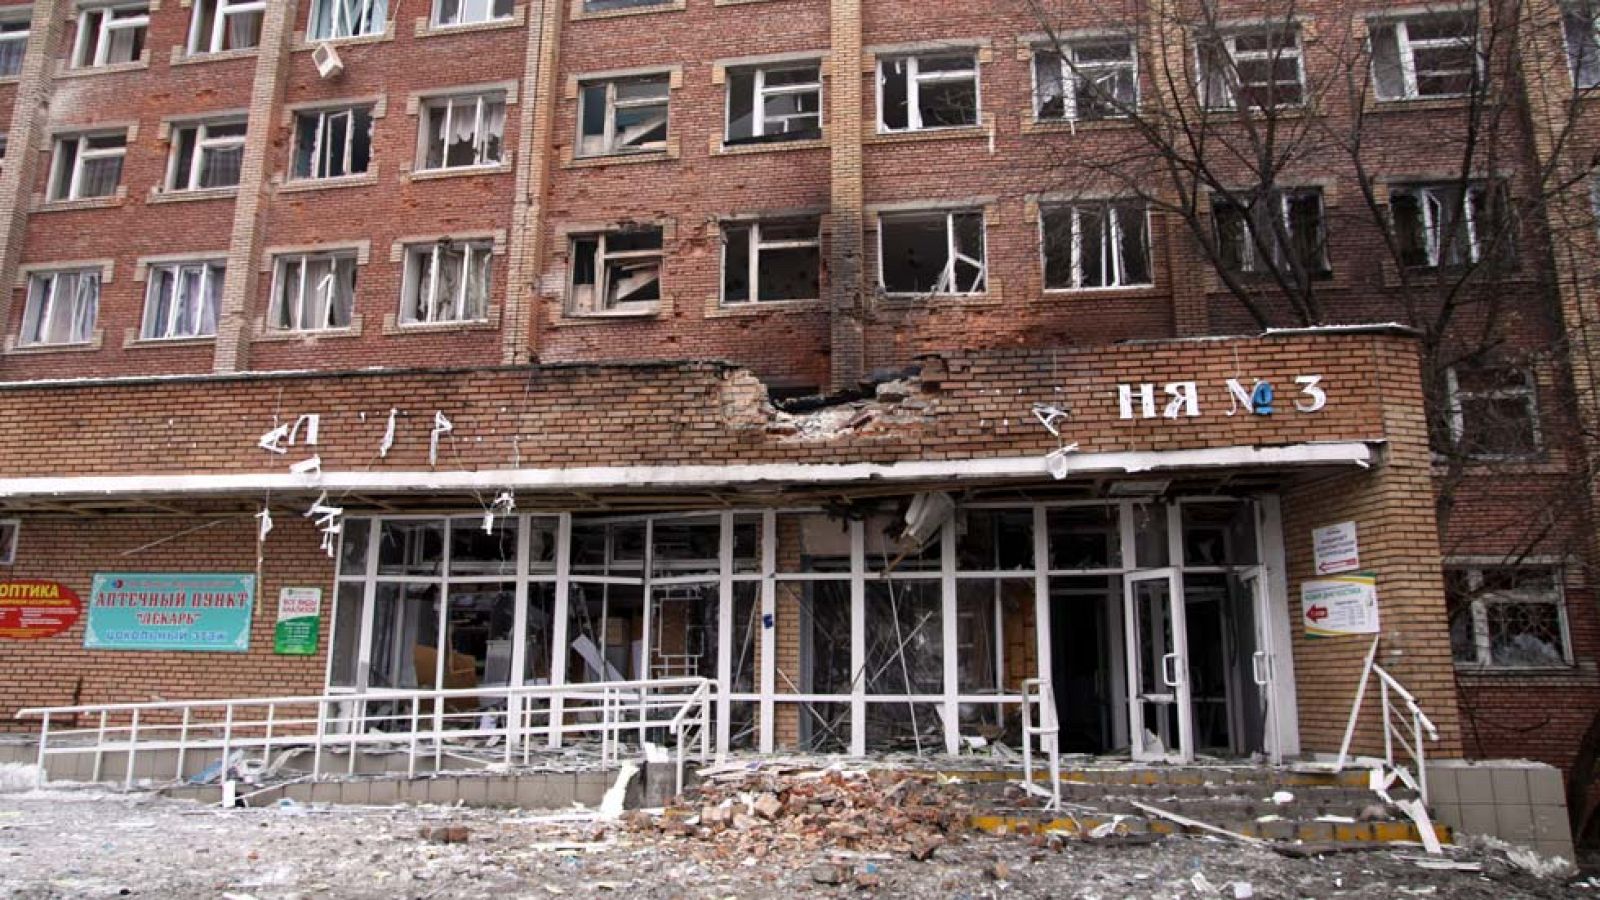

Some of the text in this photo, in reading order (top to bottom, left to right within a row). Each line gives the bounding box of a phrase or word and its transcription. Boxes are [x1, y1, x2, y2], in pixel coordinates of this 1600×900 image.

[1117, 381, 1201, 419] НЯ
[1295, 375, 1327, 413] 3
[0, 584, 59, 598] ОПТИКА
[95, 590, 249, 608] АПТЕЧНЫЙ ПУНКТ
